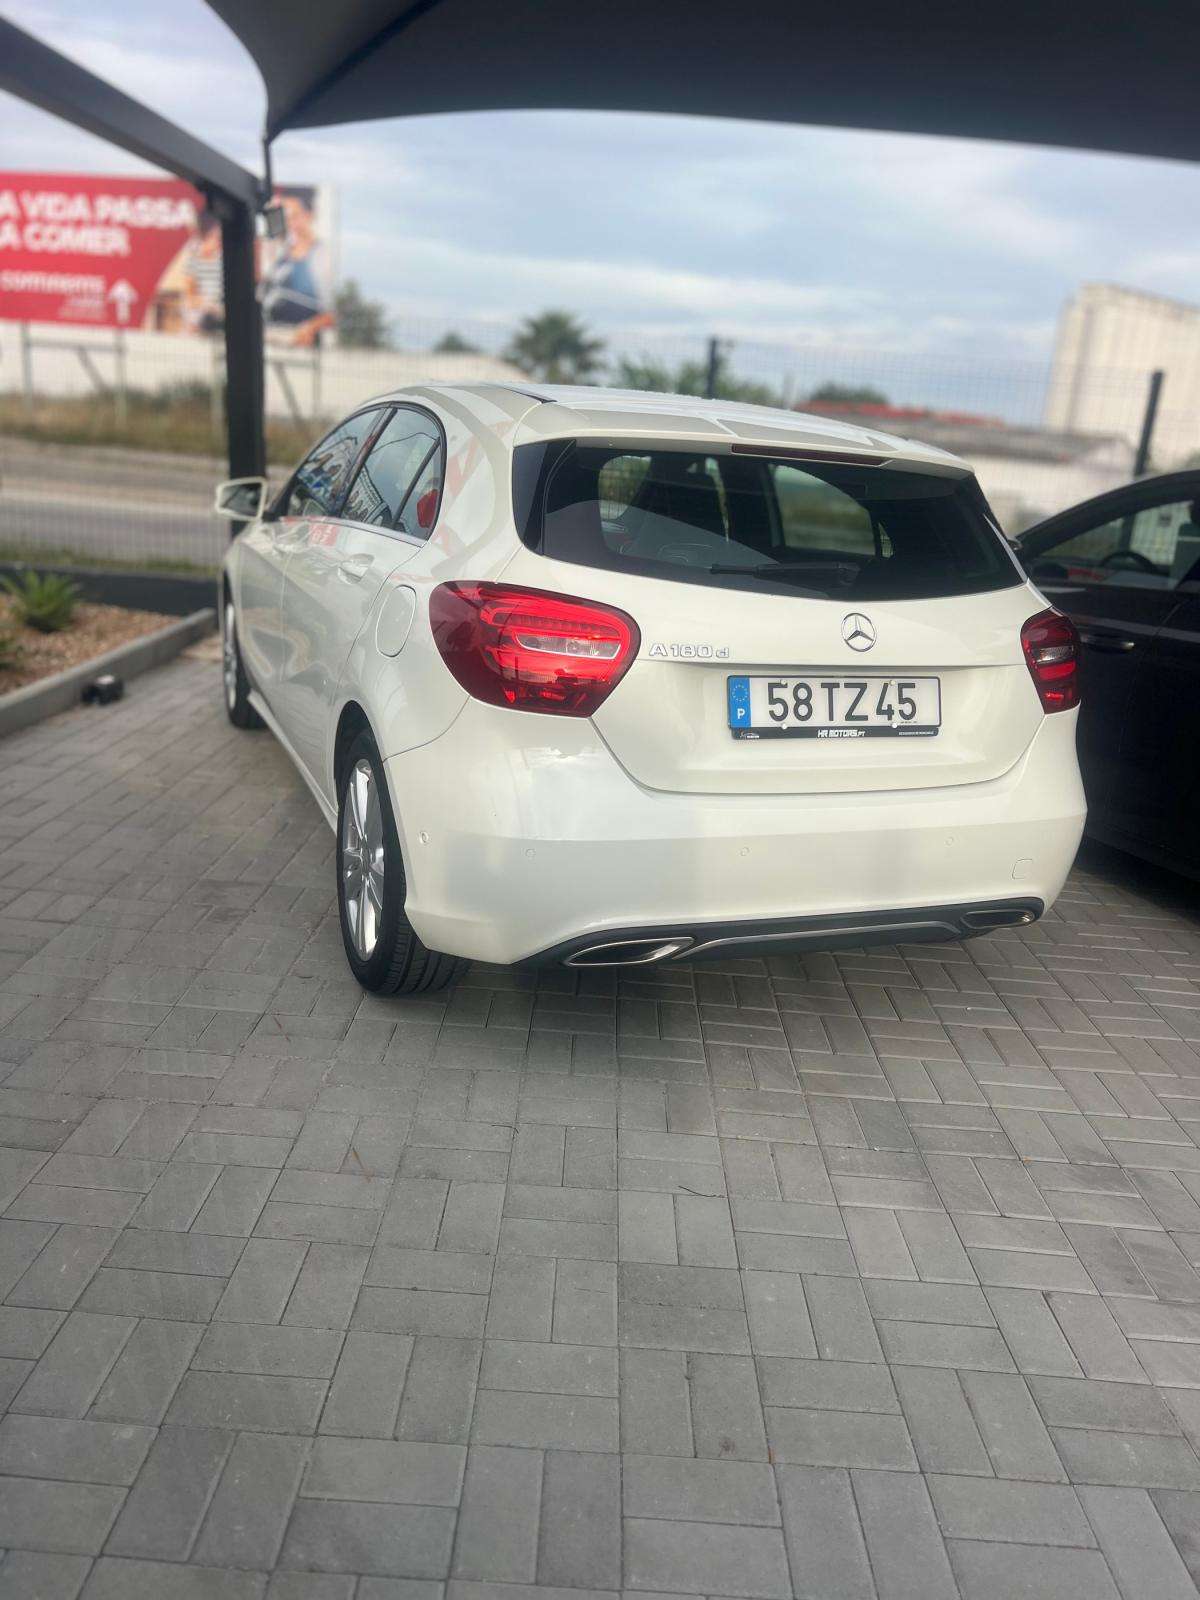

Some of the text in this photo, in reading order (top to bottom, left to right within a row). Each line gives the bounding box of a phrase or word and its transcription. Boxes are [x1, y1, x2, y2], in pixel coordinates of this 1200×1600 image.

[20, 190, 90, 222] VIDA
[94, 194, 196, 230] PASSA
[23, 222, 131, 256] COMER
[649, 643, 729, 658] A 180 d
[737, 708, 745, 719] P
[817, 730, 828, 738] HR
